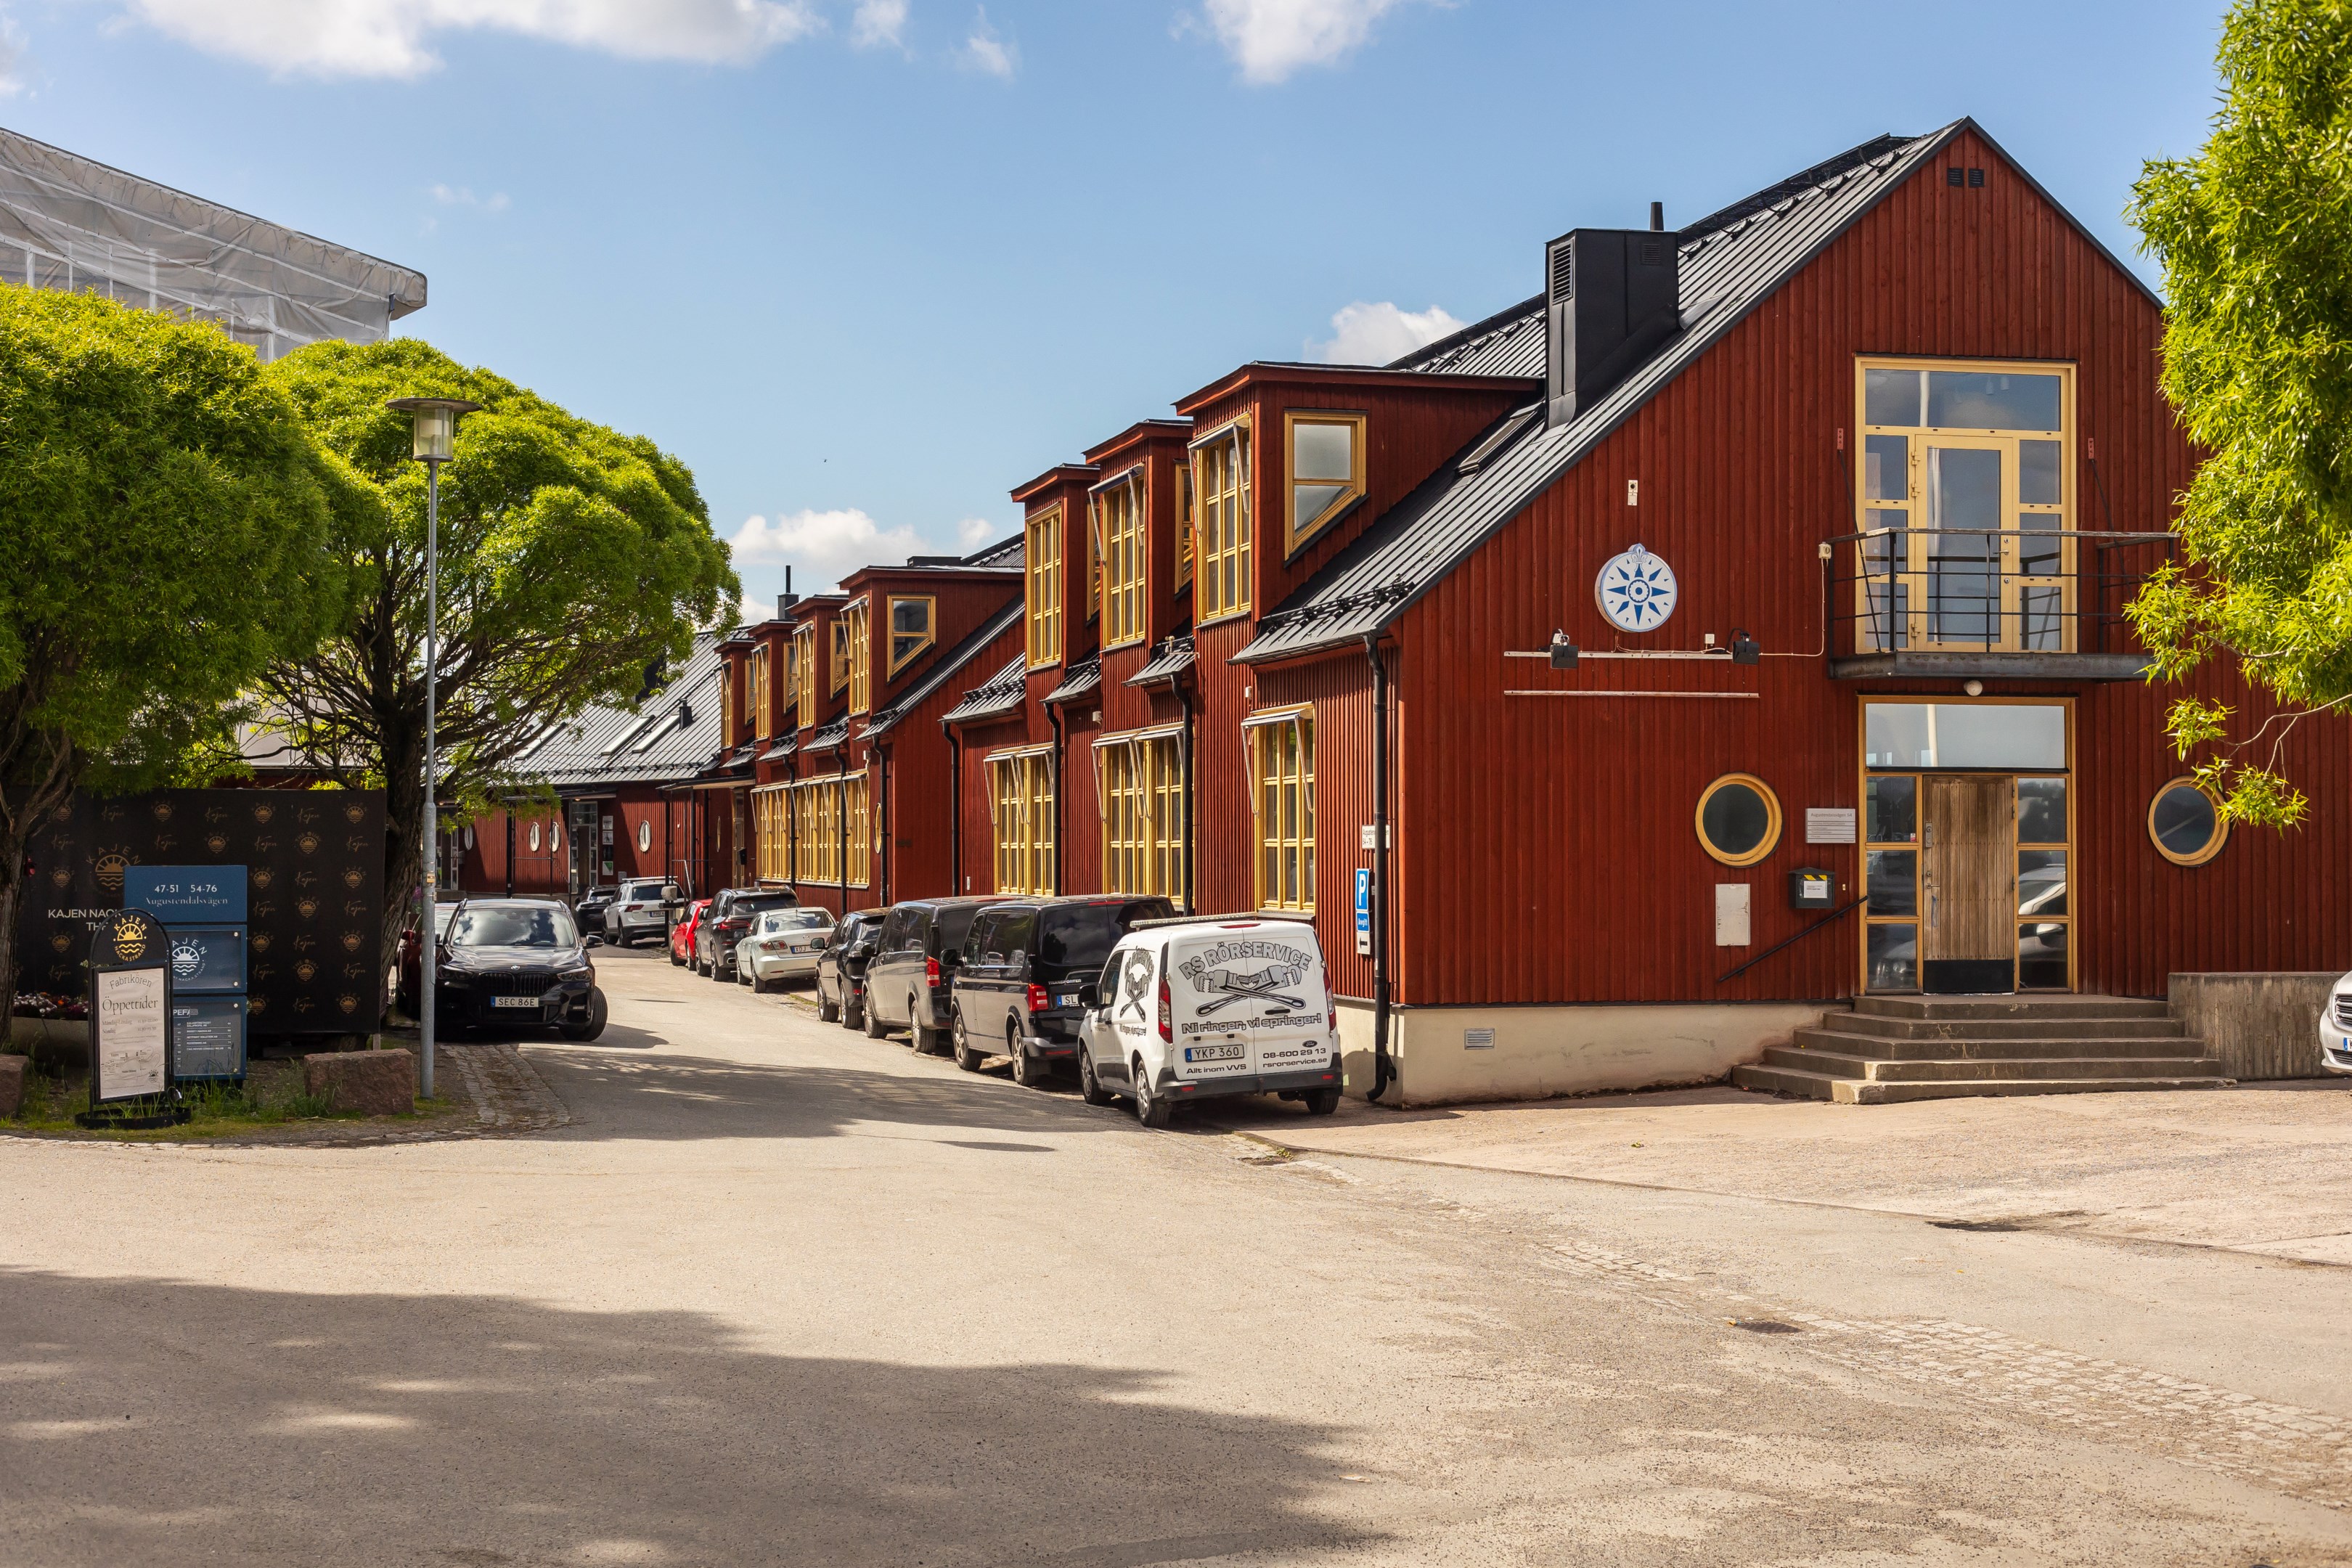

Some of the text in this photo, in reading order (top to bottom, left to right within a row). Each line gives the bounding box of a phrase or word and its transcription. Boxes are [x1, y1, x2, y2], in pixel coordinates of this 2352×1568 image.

[297, 808, 320, 824] Kajen
[255, 836, 277, 852] Kajen
[346, 836, 369, 852] Kajen
[86, 844, 143, 865] KAJEN
[295, 871, 318, 888] Kajen
[155, 884, 218, 893] 47-51 54-76
[1358, 873, 1366, 906] P
[145, 896, 229, 907] Augustendalsvägen
[253, 901, 277, 918] Kajen
[344, 900, 367, 917] Kajen
[48, 909, 121, 919] KAJEN NACK
[113, 915, 147, 931] KAJEN
[1357, 917, 1368, 928] Avgift
[172, 937, 208, 955] AJEN
[293, 935, 316, 952] Kajen
[115, 944, 146, 962] NACKA STRAND
[1179, 942, 1312, 980] RS RÖRSERVICE
[343, 963, 366, 979] Kajen
[110, 973, 152, 989] Fabrikören
[102, 995, 158, 1016] Öppettider
[293, 997, 315, 1013] Kajen
[1065, 995, 1077, 1004] SL
[1182, 1013, 1323, 1034] Ni ringer, vi springer!
[1195, 1046, 1240, 1059] YKP 360
[1263, 1050, 1299, 1059] 08-600
[1262, 1058, 1328, 1068] rsrorservice.se
